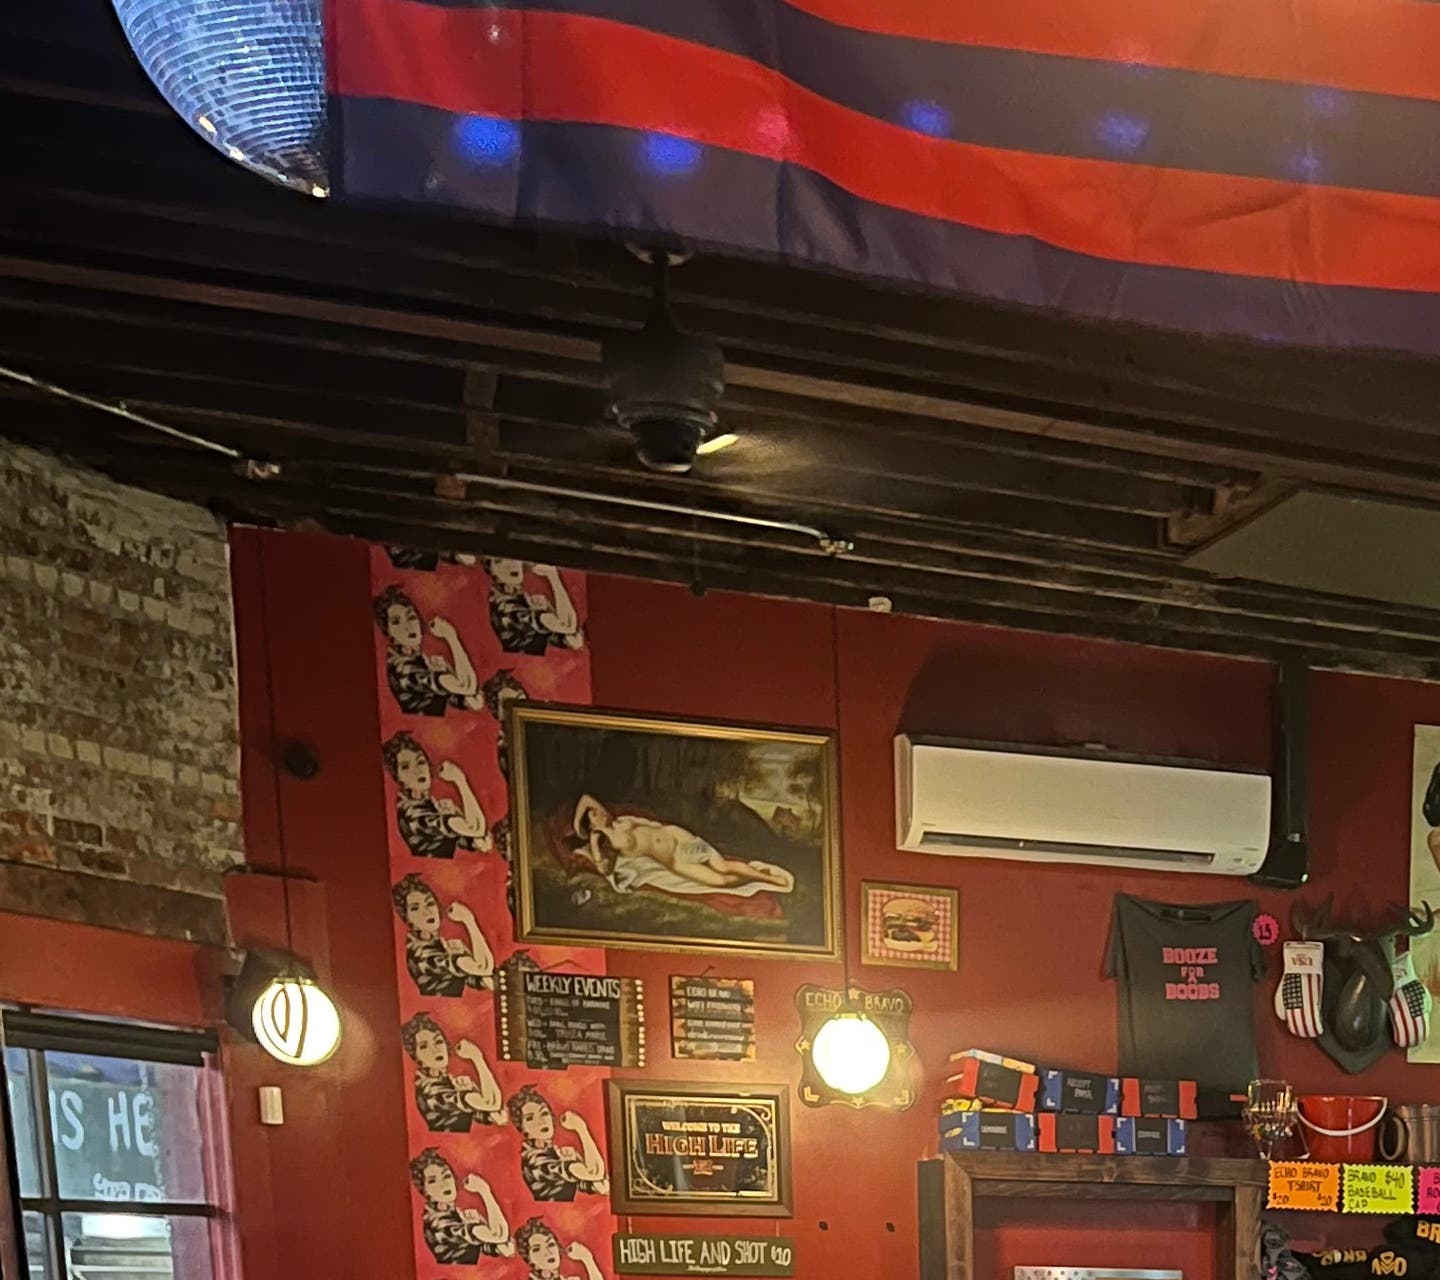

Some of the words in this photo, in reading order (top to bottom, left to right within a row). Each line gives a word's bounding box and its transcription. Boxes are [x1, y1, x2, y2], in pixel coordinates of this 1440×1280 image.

[1258, 923, 1274, 940] 15
[1162, 947, 1218, 964] BOOZE
[526, 974, 572, 994] WEEKLY
[573, 976, 621, 999] EVENTS
[1165, 983, 1221, 1000] BOOBS
[805, 992, 842, 1010] ECHO
[864, 995, 904, 1011] BRAVO
[662, 1121, 708, 1132] WELCOME
[645, 1133, 706, 1156] HIGH
[708, 1135, 759, 1158] LIFE
[1274, 1167, 1297, 1178] ECHO
[1302, 1167, 1330, 1179] BRAVO
[1347, 1169, 1377, 1182] BRAVO
[1384, 1170, 1406, 1188] $40
[1348, 1185, 1397, 1200] BASEBALL
[1350, 1201, 1368, 1209] CAP
[619, 1239, 656, 1264] HIGH
[660, 1239, 696, 1264] LIFE
[699, 1241, 730, 1266] AND
[734, 1240, 767, 1265] SHOT
[771, 1245, 792, 1266] $10
